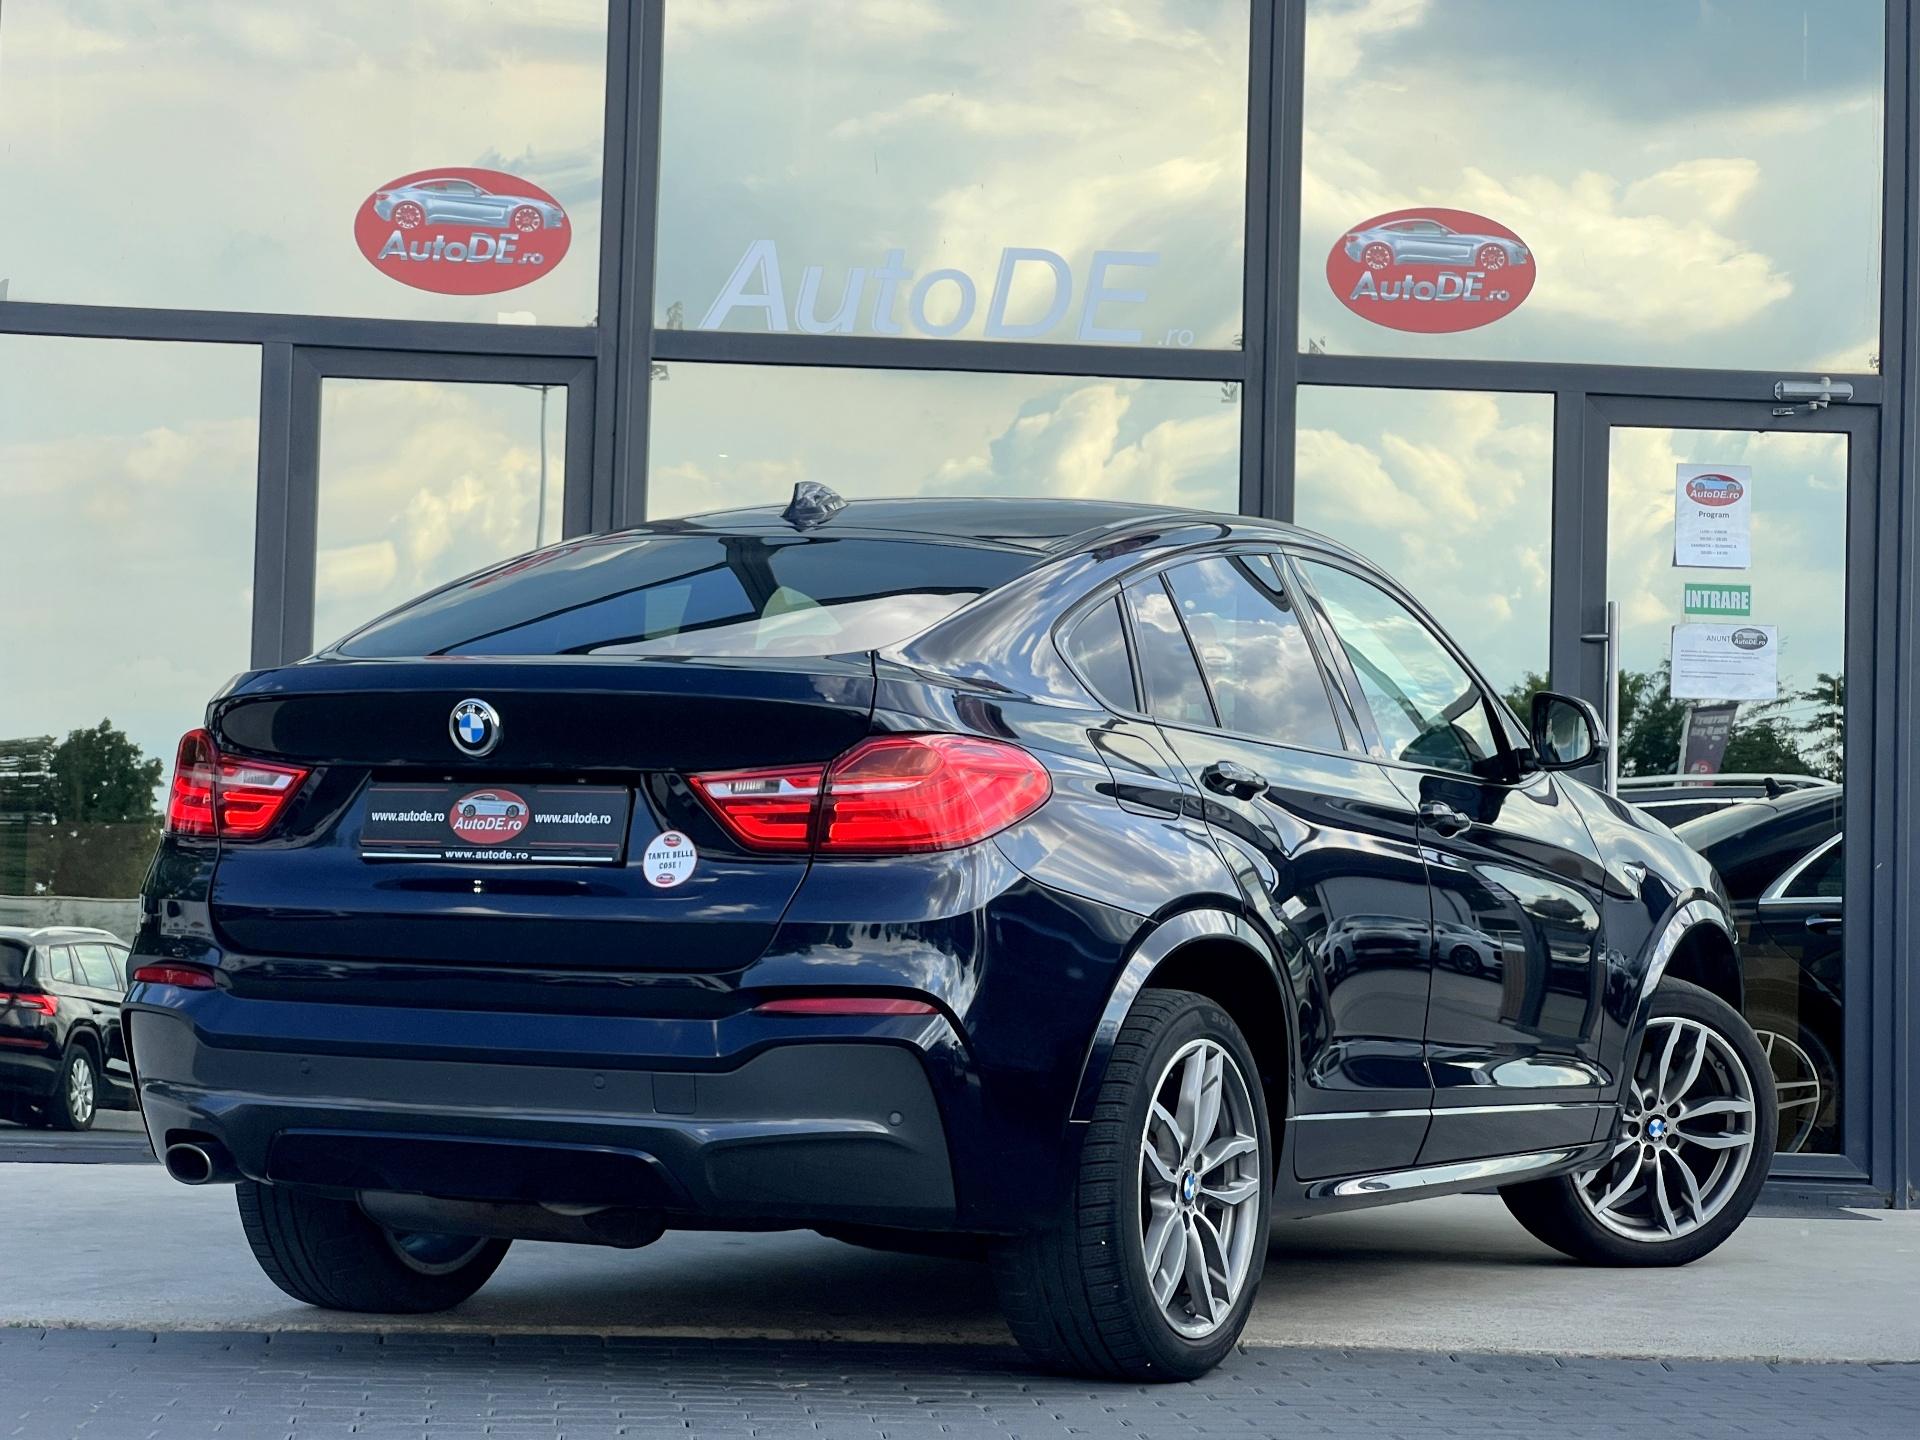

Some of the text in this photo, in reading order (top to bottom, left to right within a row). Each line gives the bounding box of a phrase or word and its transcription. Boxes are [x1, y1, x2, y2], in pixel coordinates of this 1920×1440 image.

[1690, 489, 1740, 499] AutoDE.ro
[1698, 510, 1730, 519] Program
[1685, 589, 1749, 609] INTRARE
[371, 811, 445, 822] www.autode.ro
[535, 813, 612, 825] www.autode.ro
[453, 817, 522, 831] AutoDE.ro
[445, 850, 529, 861] www.autode.ro
[648, 850, 694, 860] TANTE BELLE
